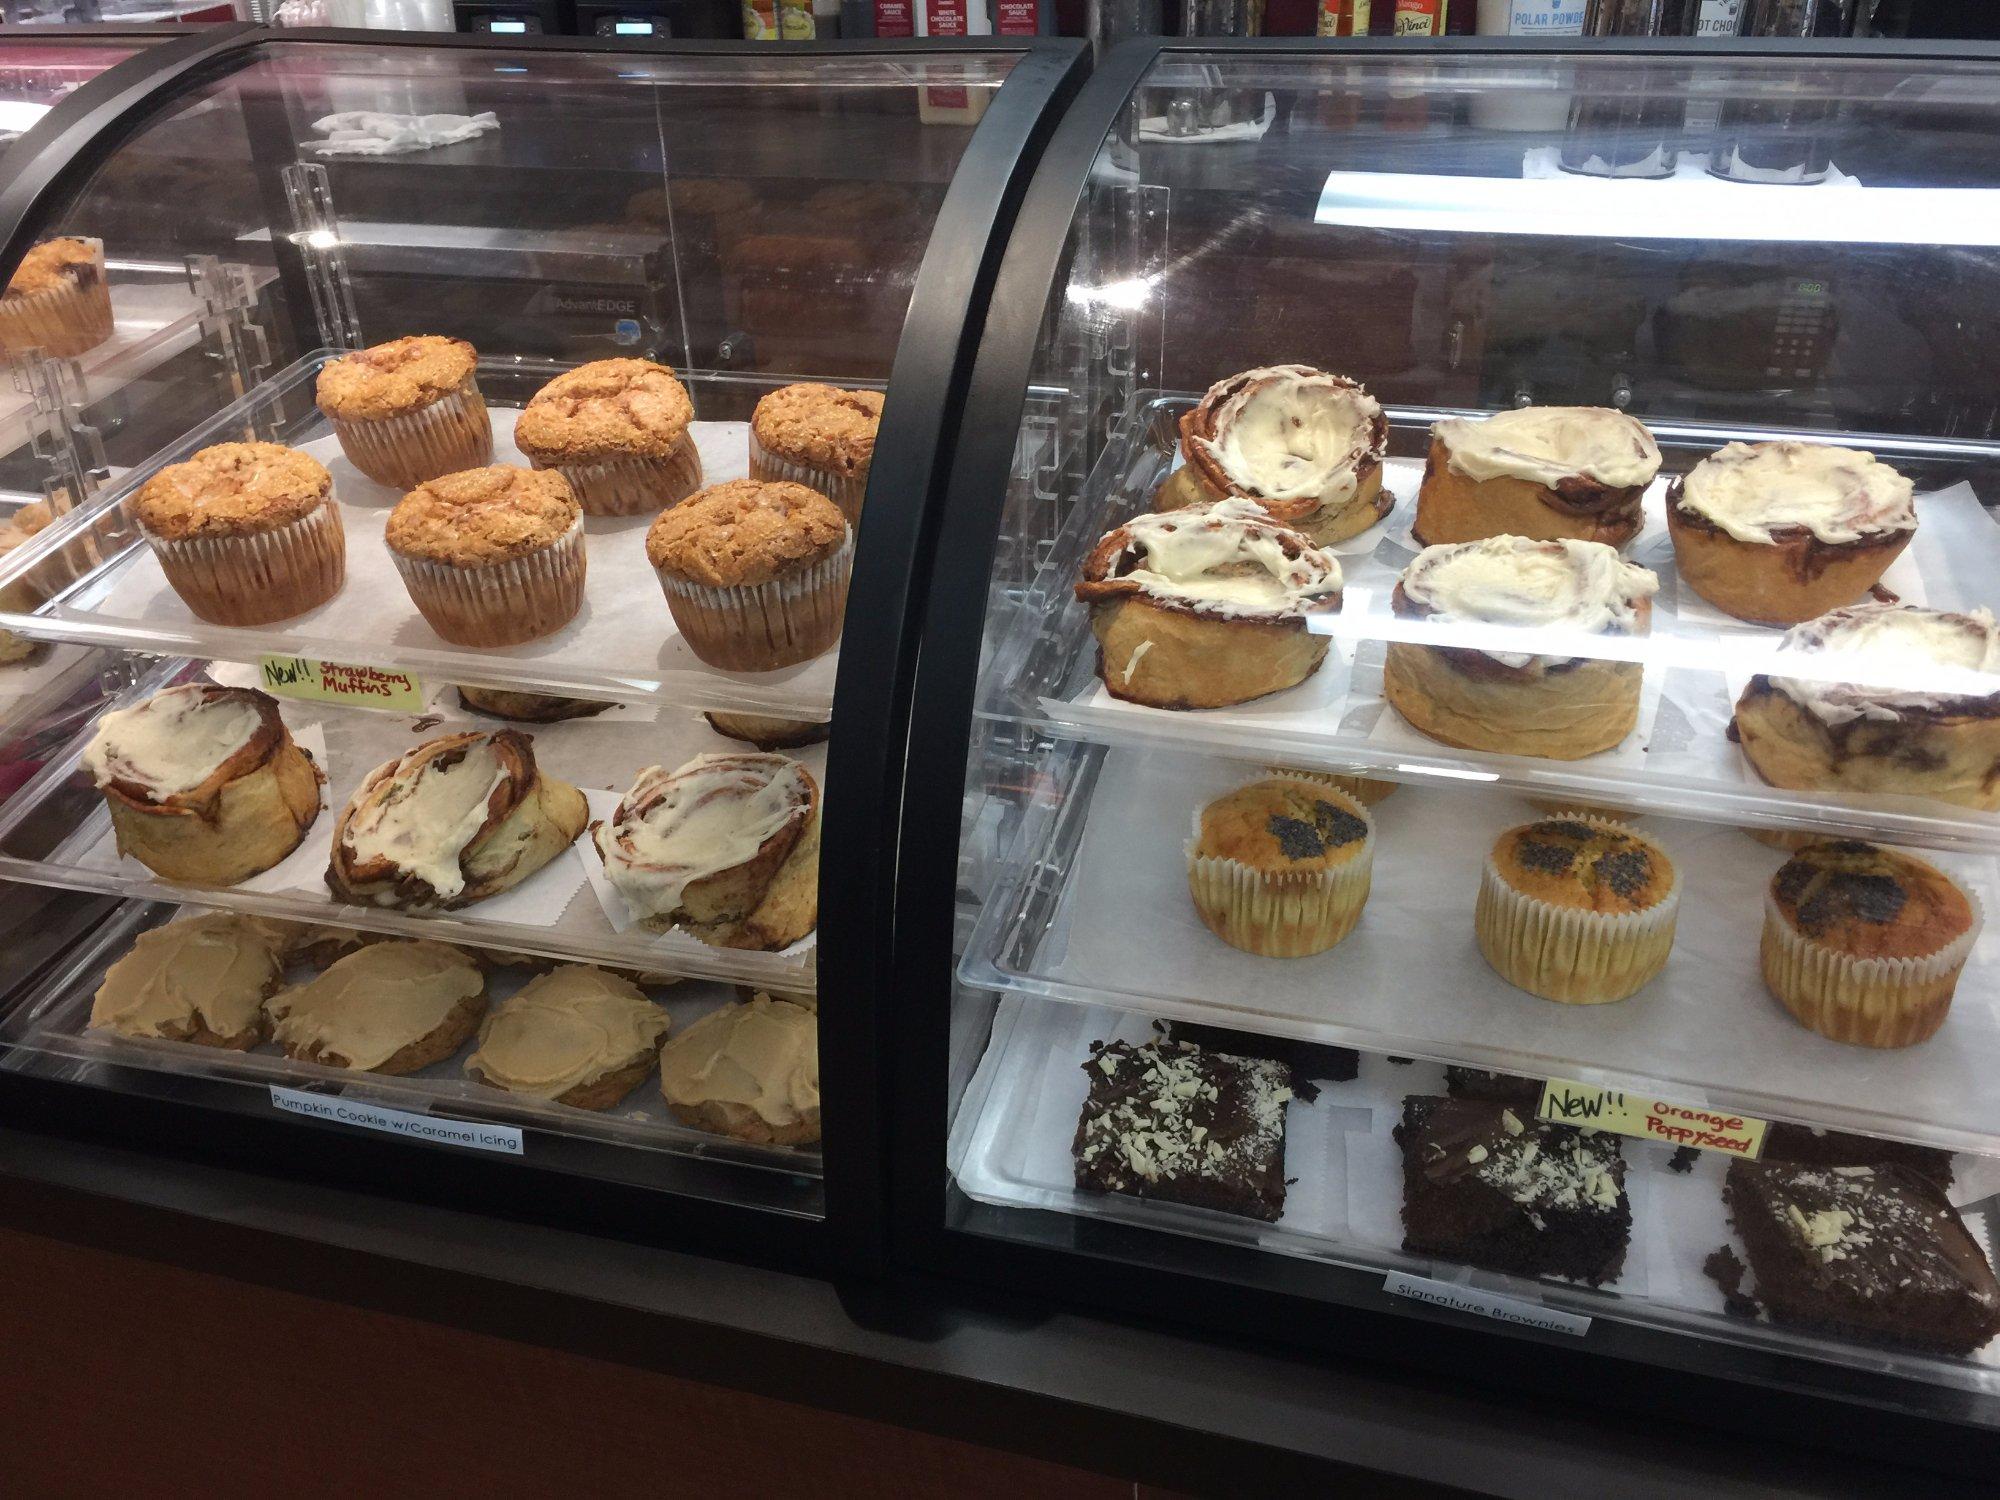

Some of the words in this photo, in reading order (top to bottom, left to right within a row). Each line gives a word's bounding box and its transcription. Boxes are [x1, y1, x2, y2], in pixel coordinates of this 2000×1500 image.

[930, 15, 964, 23] CHOCOLATE
[1515, 12, 1549, 26] POLAR
[1551, 11, 1585, 25] POWDE
[264, 658, 314, 687] New!!
[319, 661, 412, 692] Strawberry
[322, 675, 393, 697] Muffins
[272, 1093, 334, 1117] Pumpkin
[336, 1106, 388, 1128] Cookie
[391, 1120, 476, 1143] w/Caramel
[479, 1132, 518, 1151] Icing
[1549, 1088, 1629, 1119] New!!
[1652, 1101, 1745, 1132] Orange
[1645, 1115, 1754, 1154] Poppyseed
[1492, 1307, 1576, 1335] Brownies
